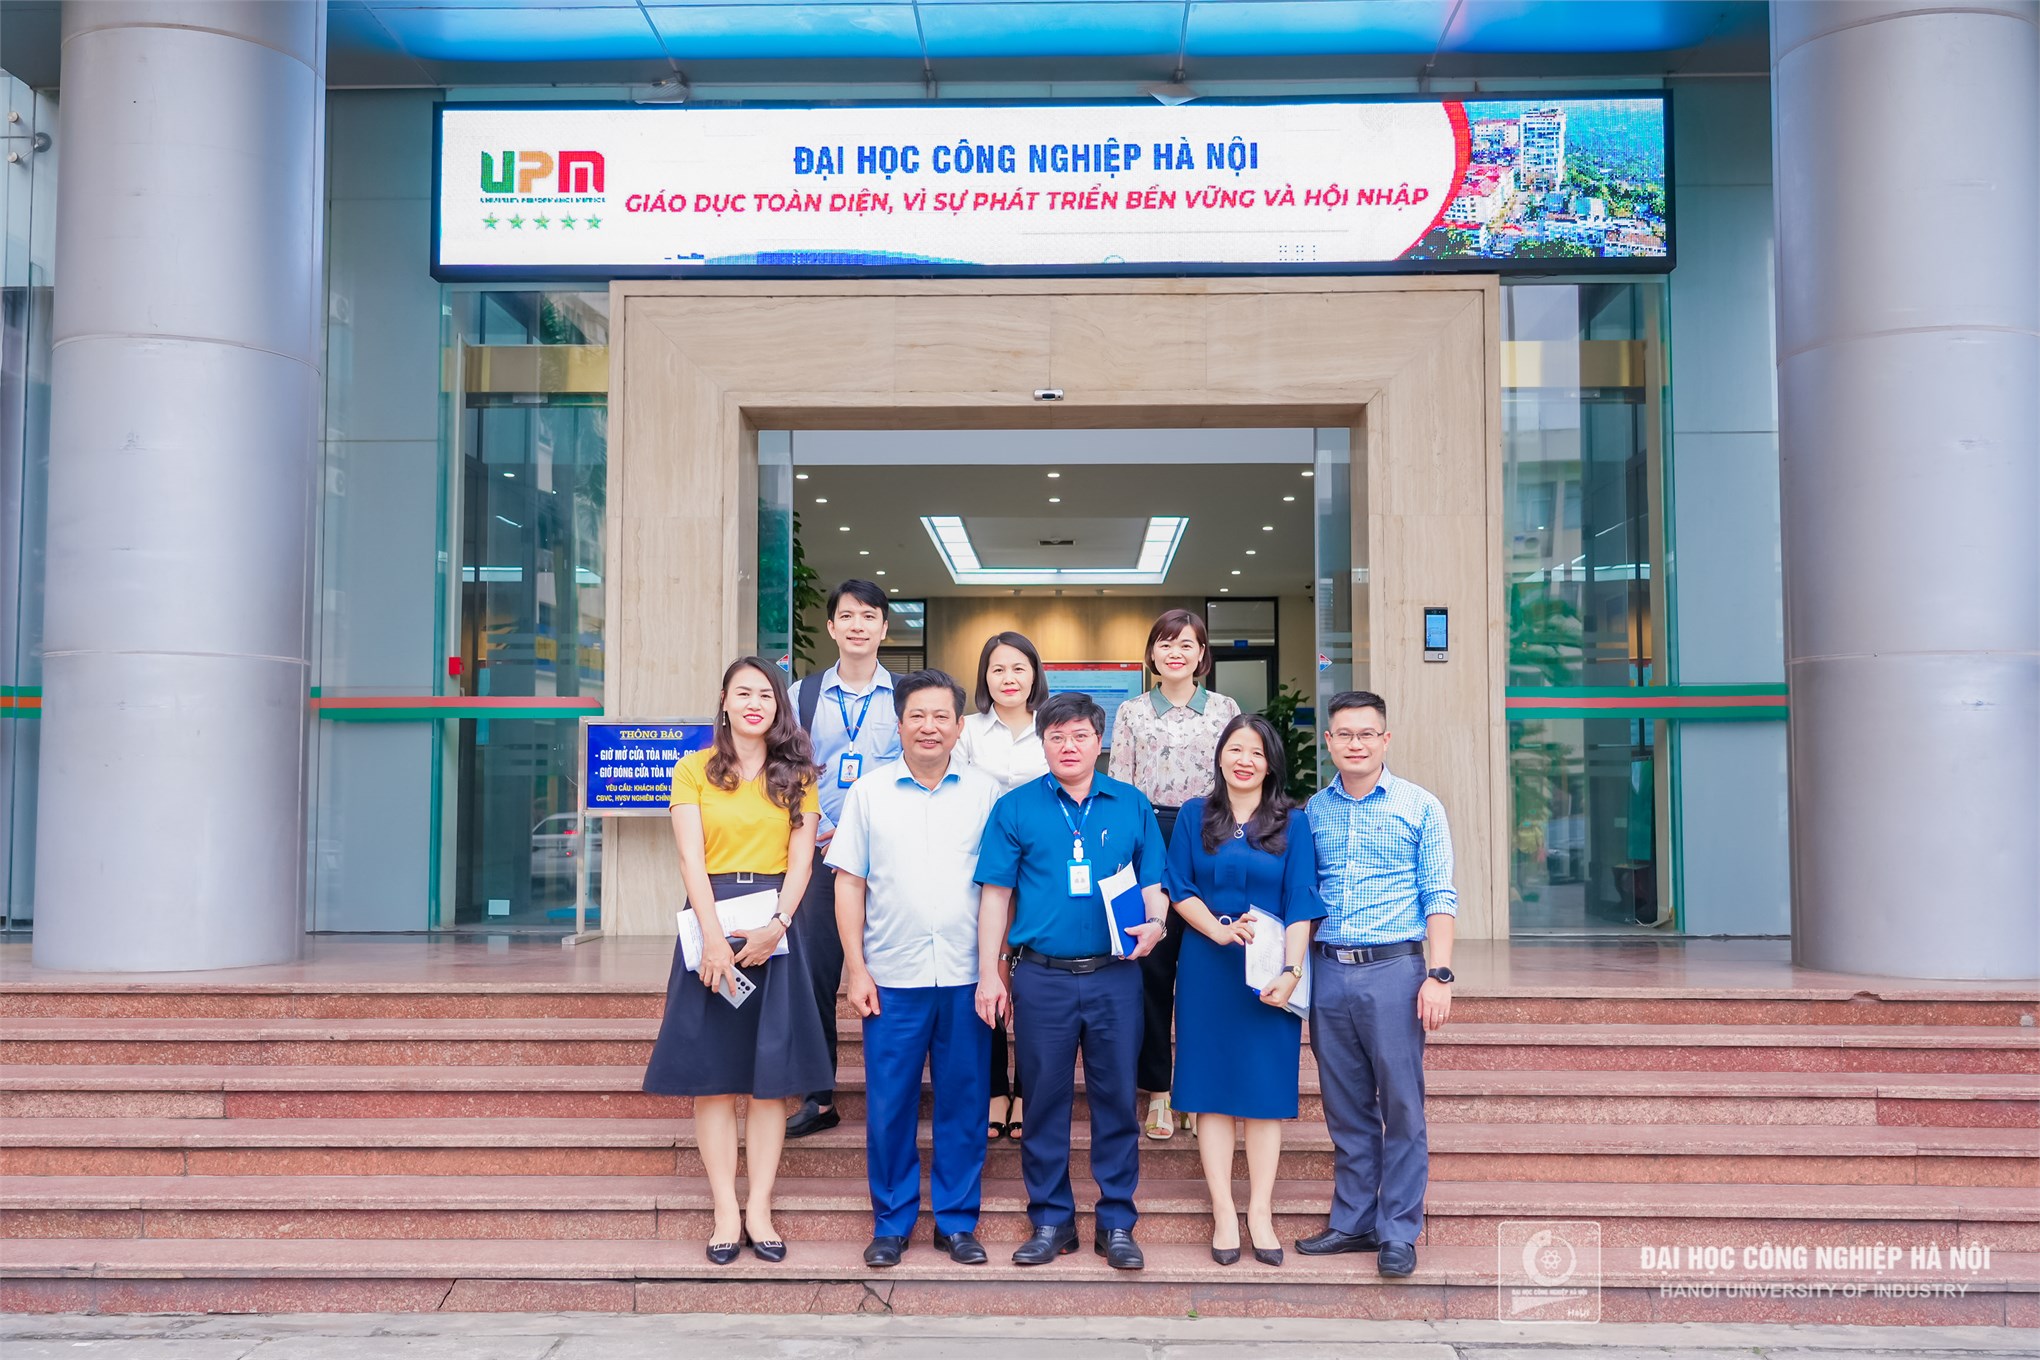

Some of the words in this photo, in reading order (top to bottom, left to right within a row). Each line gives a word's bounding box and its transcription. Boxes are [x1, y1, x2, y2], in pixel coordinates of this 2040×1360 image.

[793, 146, 844, 181] ĐẠI
[857, 145, 920, 181] HỌC
[933, 139, 1016, 174] CÔNG
[1029, 137, 1141, 178] NGHIỆP
[1153, 136, 1195, 171] HÀ
[1206, 136, 1258, 177] NỘI
[481, 150, 605, 193] UPM
[624, 189, 687, 213] GIÁO
[694, 193, 746, 217] DỤC
[753, 188, 822, 212] TOÀN
[829, 188, 894, 217] DIỆN,
[903, 187, 927, 211] VÌ
[933, 188, 969, 217] SỰ
[973, 187, 1040, 211] PHÁT
[1047, 183, 1119, 210] TRIỂN
[1125, 184, 1176, 209] BỀN
[1185, 184, 1255, 209] VỮNG
[1264, 183, 1296, 207] VÀ
[1304, 183, 1349, 212] HỘI
[1356, 182, 1429, 211] NHẬP
[620, 728, 658, 738] THÔNG
[661, 728, 683, 738] BÁO
[600, 747, 614, 760] GIỜ
[615, 745, 628, 760] MỞ
[629, 745, 644, 760] CỬA
[646, 747, 660, 760] TÒA
[662, 747, 680, 760] NHÀ:
[600, 764, 613, 777] GIỜ
[613, 765, 633, 778] ĐÓNG
[634, 763, 649, 777] CỬA
[651, 764, 665, 777] TÒA
